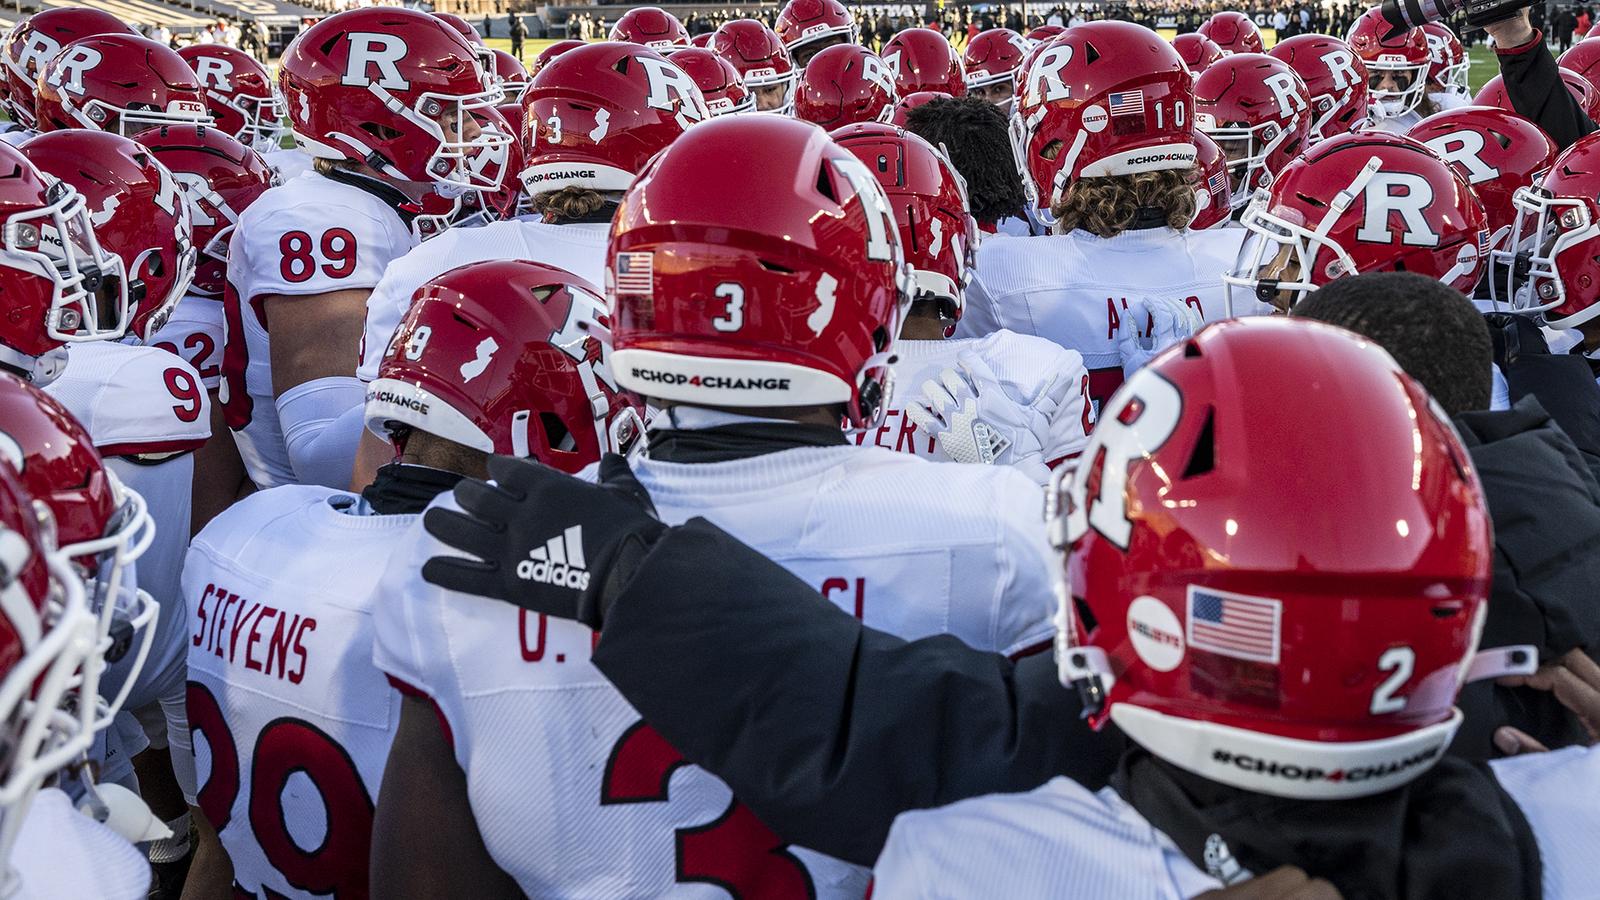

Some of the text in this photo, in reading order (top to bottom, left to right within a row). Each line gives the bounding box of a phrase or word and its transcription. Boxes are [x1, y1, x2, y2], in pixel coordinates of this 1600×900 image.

[806, 25, 824, 34] FTC
[48, 45, 104, 95] R
[196, 55, 234, 92] R
[340, 32, 412, 90] R
[1026, 44, 1073, 109] R
[1320, 50, 1361, 91] R
[178, 102, 202, 112] FTC
[633, 56, 703, 122] R
[1263, 72, 1307, 119] R
[1083, 115, 1107, 123] BELIEVE
[1127, 153, 1195, 165] #CHOP4CHANG
[1356, 170, 1440, 248] R
[279, 227, 358, 283] 89
[712, 281, 745, 333] 3
[163, 367, 202, 423] 9
[631, 367, 791, 391] #CHOP4CHANGE
[1049, 367, 1184, 554] R
[516, 558, 592, 592] adidas
[192, 582, 317, 685] STEVENS
[1369, 645, 1417, 716] 2
